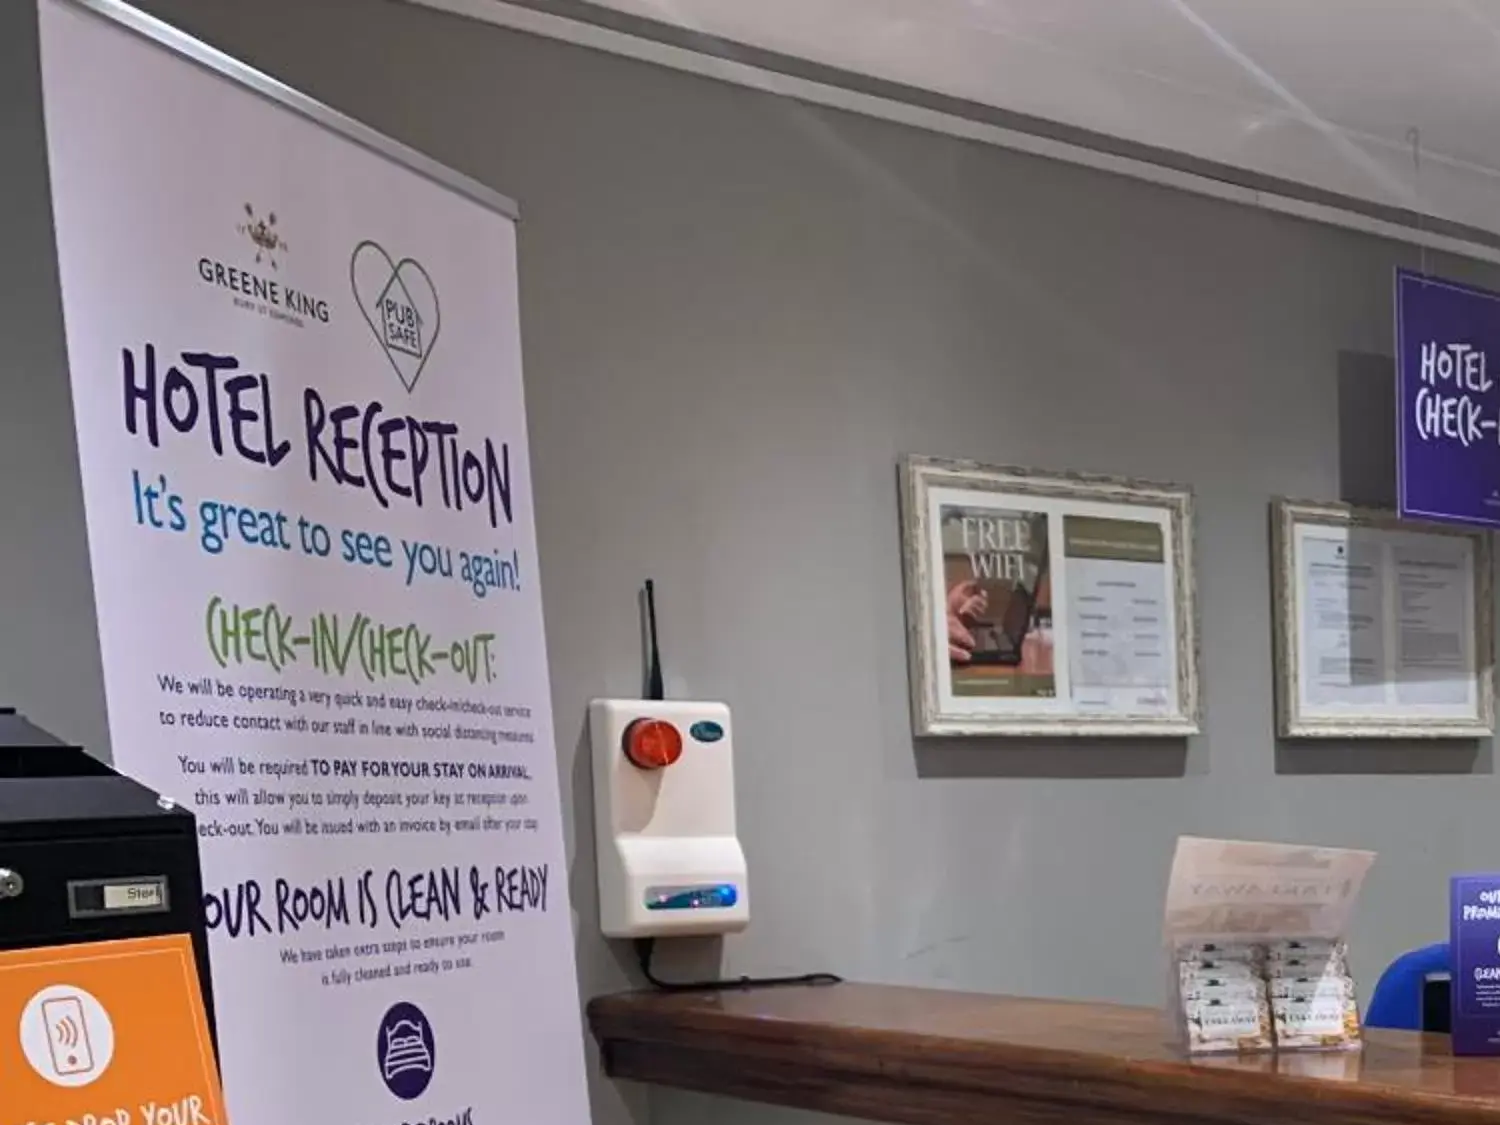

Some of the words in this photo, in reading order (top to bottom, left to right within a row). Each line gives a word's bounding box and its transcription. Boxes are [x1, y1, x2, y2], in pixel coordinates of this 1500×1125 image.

[199, 258, 280, 305] GREENE
[285, 286, 330, 323] KING
[385, 299, 415, 327] PUB
[388, 322, 417, 350] SAFE
[1421, 341, 1493, 393] HOTEL
[122, 343, 291, 467] HOTEL
[304, 387, 513, 528] RECEPTION
[131, 469, 187, 531] It's
[199, 499, 289, 554] great
[298, 513, 330, 558] to
[341, 527, 393, 568] see
[401, 539, 452, 586] you
[459, 548, 521, 599] again!
[961, 515, 1030, 552] FREE
[158, 675, 183, 694] We
[188, 678, 213, 695] will
[217, 680, 233, 697] be
[239, 686, 296, 707] operating
[309, 692, 330, 707] very
[335, 691, 361, 709] quick
[366, 694, 385, 708] and
[390, 698, 412, 713] easy
[159, 712, 175, 725] to
[181, 710, 228, 728] reduce
[234, 716, 280, 730] contact
[285, 716, 308, 732] with
[312, 721, 329, 733] our
[333, 718, 355, 734] staff
[359, 724, 368, 734] in
[372, 720, 391, 736] line
[395, 723, 418, 736] with
[178, 756, 204, 773] You
[210, 757, 234, 774] will
[239, 758, 254, 774] be
[260, 760, 307, 780] required
[311, 759, 330, 776] TO
[334, 760, 357, 776] PAY
[362, 761, 390, 777] FOR
[391, 762, 430, 777] YOUR
[434, 762, 464, 778] STAY
[468, 763, 486, 778] ON
[195, 788, 220, 805] this
[225, 788, 248, 804] will
[252, 789, 284, 805] allow
[289, 794, 308, 810] you
[312, 793, 323, 805] to
[256, 819, 278, 835] You
[283, 819, 301, 834] will
[305, 819, 318, 834] be
[357, 820, 381, 832] with
[200, 880, 272, 938] OUR
[276, 877, 349, 934] ROOM
[357, 870, 377, 928] IS
[386, 866, 461, 929] CLEAN
[469, 866, 490, 919] &
[496, 863, 548, 913] READY
[280, 949, 298, 963] We
[301, 949, 323, 962] have
[325, 945, 350, 959] taken
[353, 944, 379, 956] extra
[458, 934, 479, 948] your
[354, 964, 391, 981] cleaned
